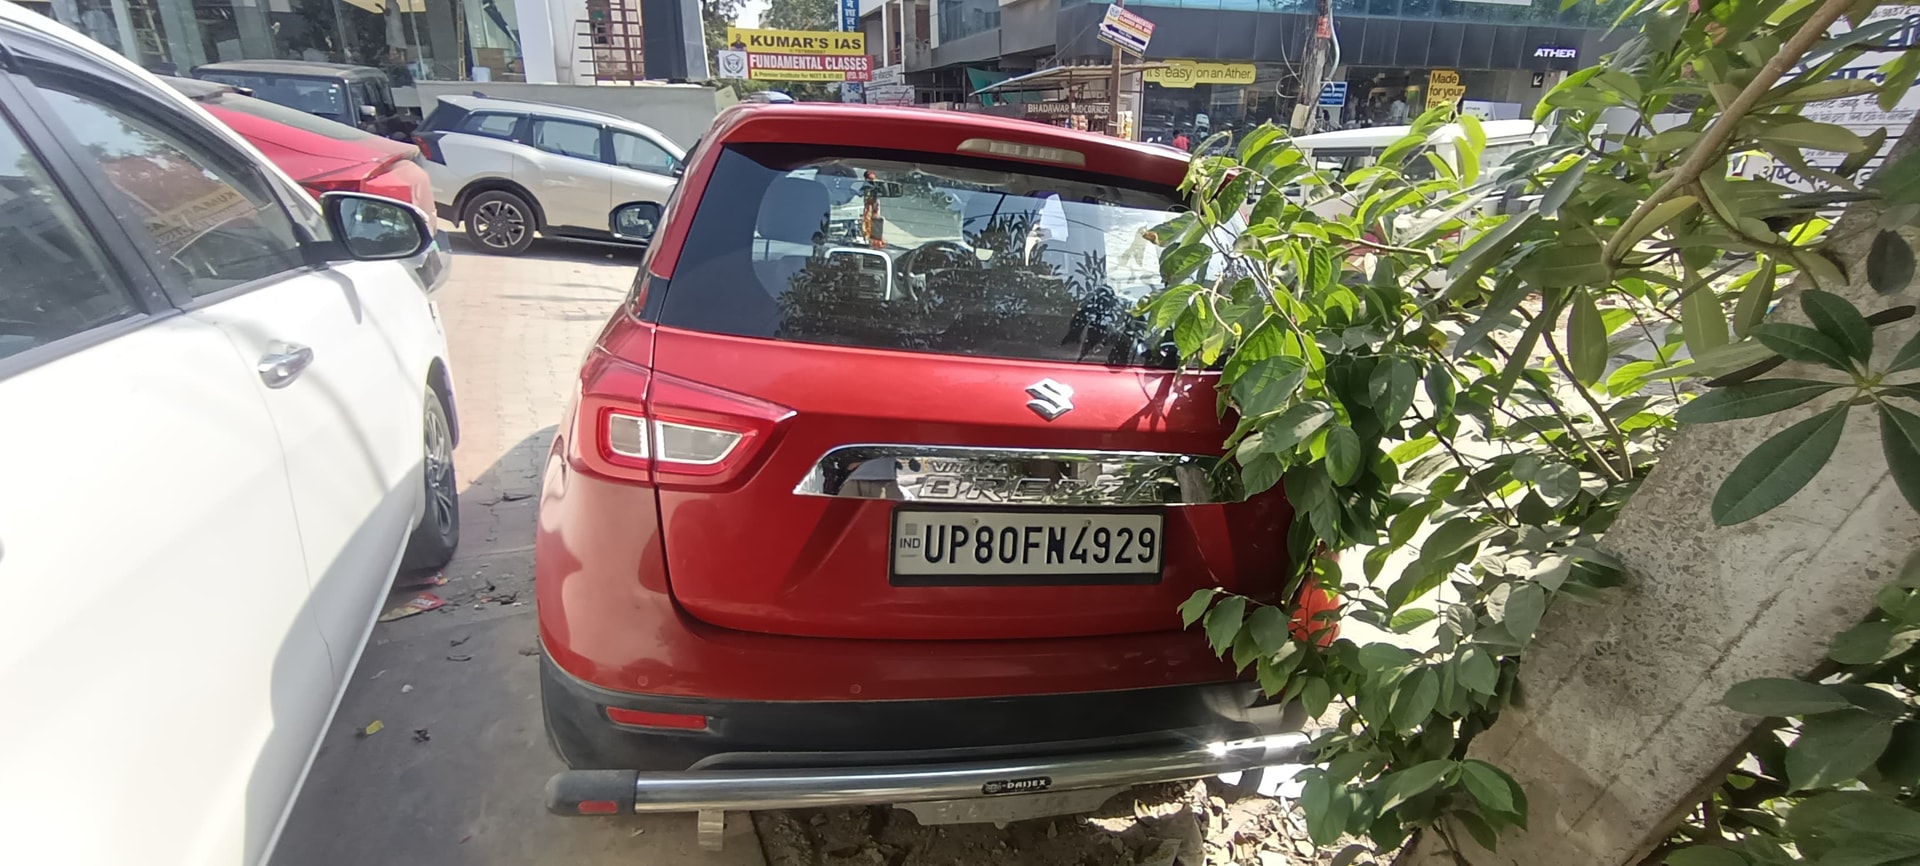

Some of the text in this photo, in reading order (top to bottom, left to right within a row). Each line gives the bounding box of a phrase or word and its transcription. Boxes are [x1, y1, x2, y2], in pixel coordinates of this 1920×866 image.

[750, 35, 861, 50] KUMAR'S IAS
[1534, 48, 1576, 58] ATHER
[750, 54, 867, 70] FUNDAMENTAL CLASSES
[1165, 68, 1192, 81] easy
[1196, 69, 1209, 78] on
[1210, 70, 1223, 79] an
[1224, 68, 1252, 79] Ather.
[1432, 73, 1457, 84] Made
[1429, 86, 1463, 98] for your
[1027, 103, 1070, 113] BHADAWAR
[929, 460, 1008, 474] VITARA
[917, 474, 1162, 501] BREZZA
[899, 525, 1156, 564] IND UP80FN4929
[1007, 779, 1046, 789] DAIJEX
